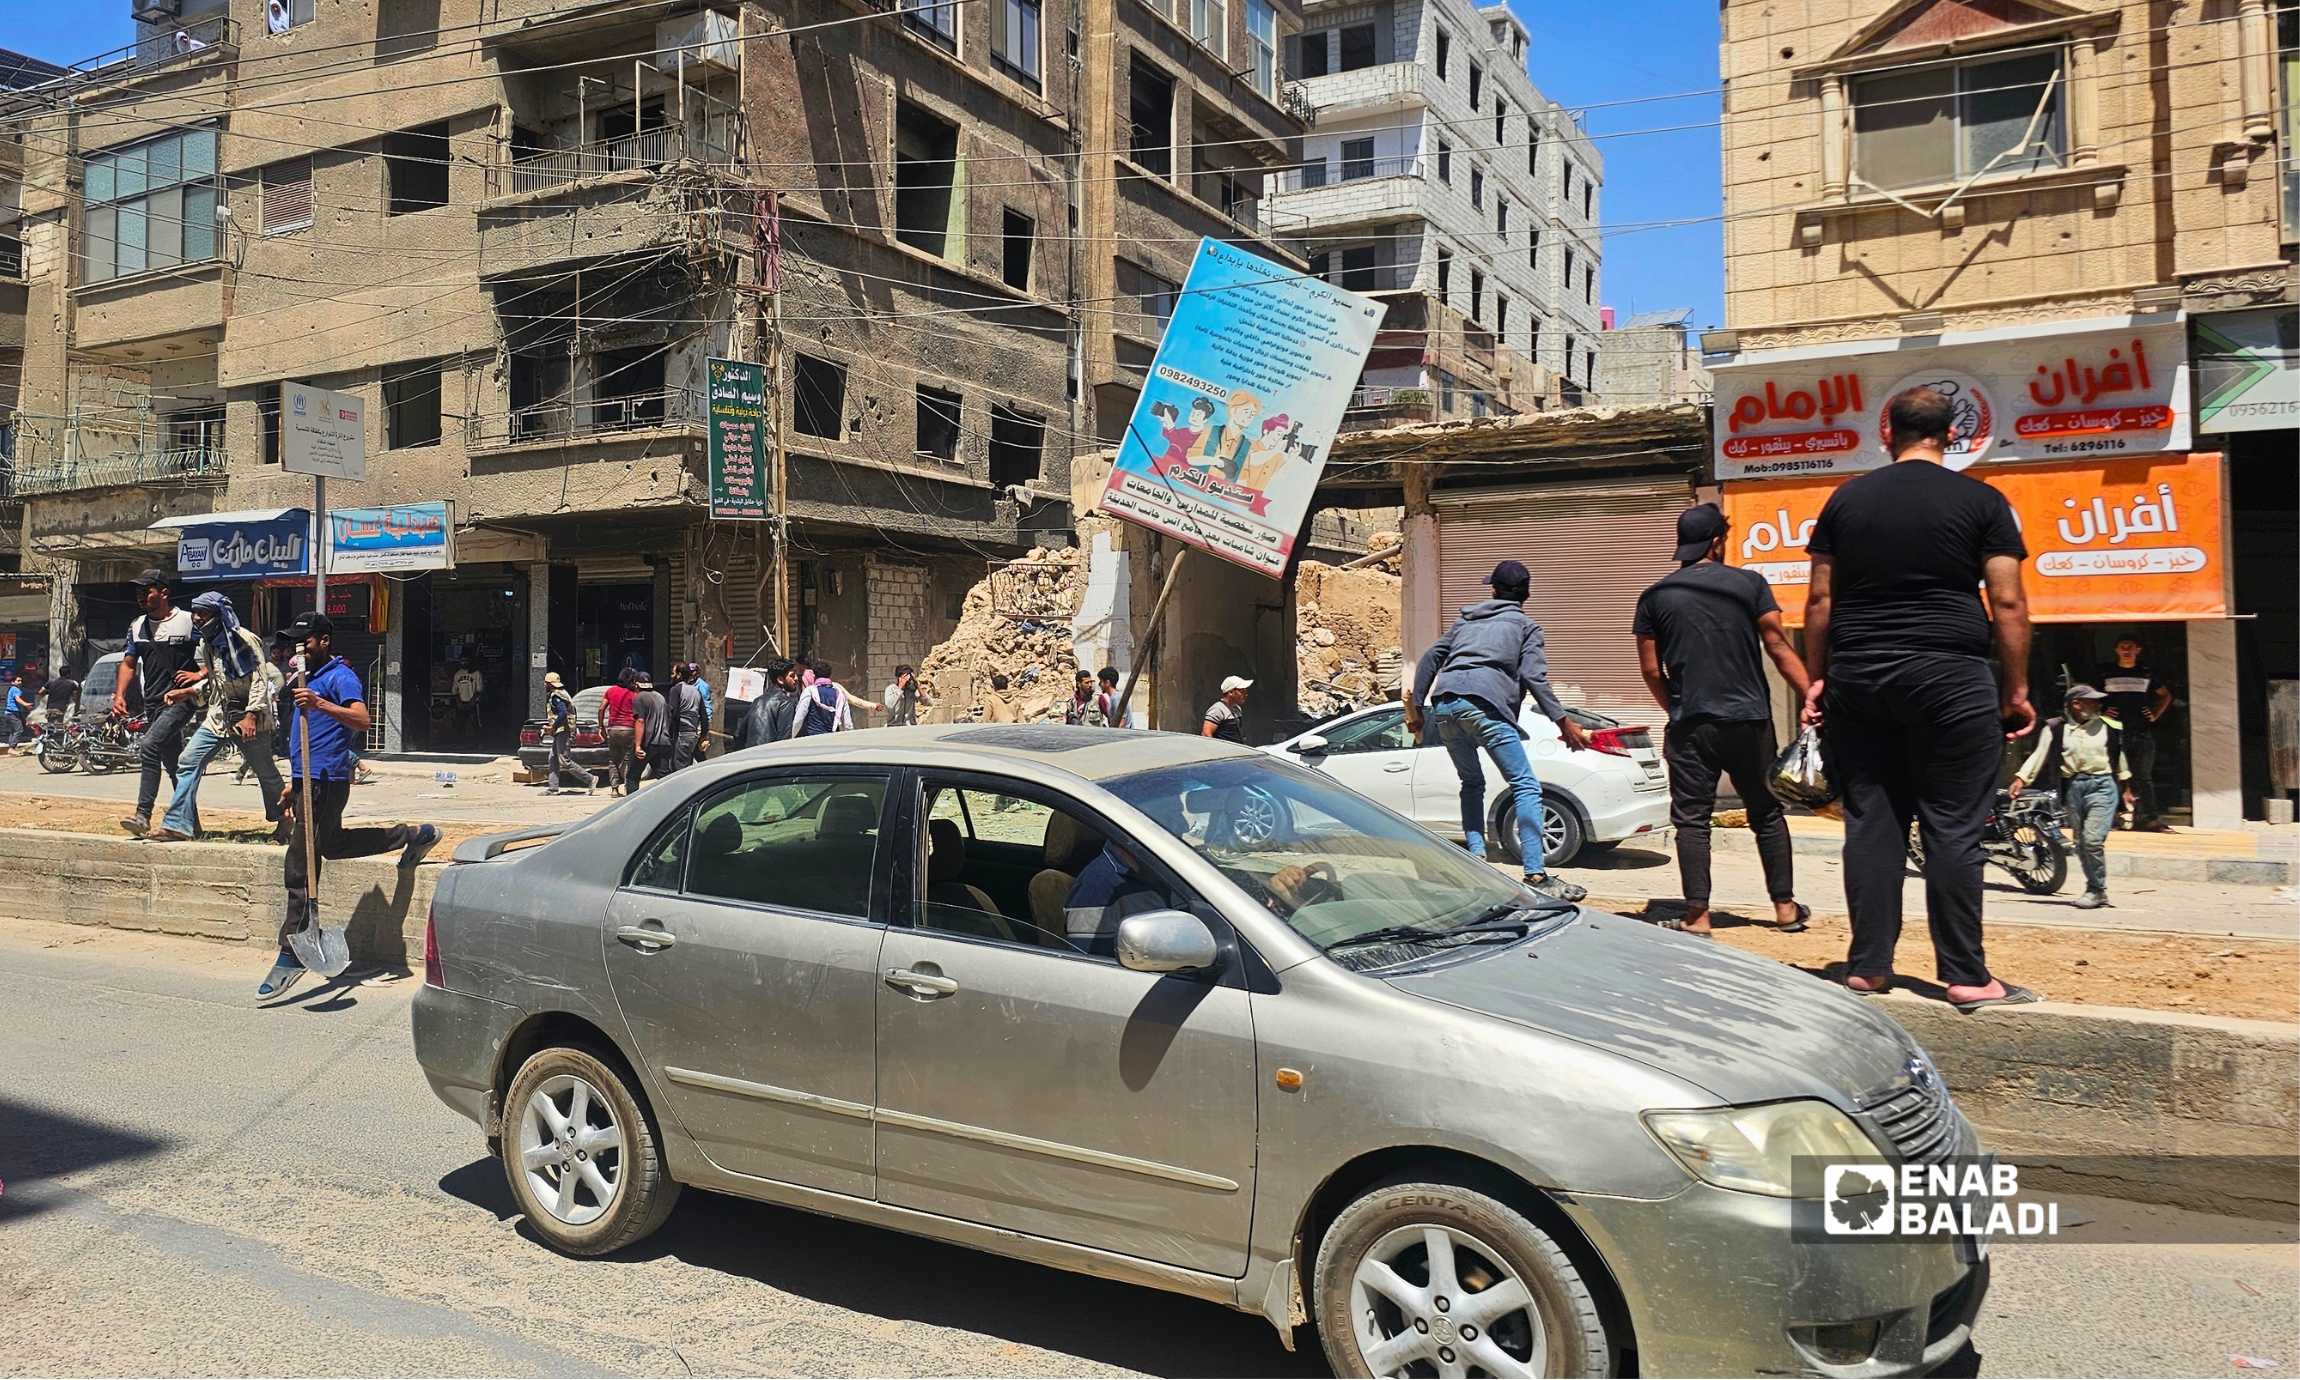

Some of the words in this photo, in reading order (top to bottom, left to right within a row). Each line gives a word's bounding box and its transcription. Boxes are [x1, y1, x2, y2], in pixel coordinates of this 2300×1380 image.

[1308, 290, 1332, 299] الكرم
[722, 368, 751, 381] الدكتور
[1159, 366, 1226, 397] 0982493250
[2028, 338, 2153, 407] أفران
[711, 383, 739, 400] الصادق
[741, 391, 761, 405] وسيم
[1728, 373, 1864, 434] الإمام
[2229, 402, 2300, 418] 0956216
[2019, 417, 2051, 433] كعك
[2069, 411, 2123, 432] كروسان
[2140, 406, 2167, 429] خبز
[1727, 439, 1749, 456] كيك
[1805, 430, 1849, 452] باتسيري
[2043, 442, 2069, 455] Tel:
[2069, 438, 2126, 452] 6296116
[1168, 464, 1207, 487] الكرم
[1744, 458, 1834, 474] Mob:0985116116
[1126, 480, 1173, 504] والجامعات
[1206, 478, 1255, 499] ستديو
[1107, 491, 1137, 509] الحديقة
[1137, 507, 1159, 520] جانب
[1177, 499, 1218, 521] للمدارس
[2057, 483, 2178, 544] أفران
[337, 514, 382, 544] غسان
[383, 509, 441, 541] صيدلية
[1180, 522, 1203, 536] جامع
[1219, 513, 1253, 534] شخصية
[1203, 531, 1220, 544] بعد
[1254, 531, 1276, 543] صور
[2042, 556, 2073, 571] كعك
[2093, 552, 2149, 571] كروسان
[2168, 551, 2195, 570] خبز
